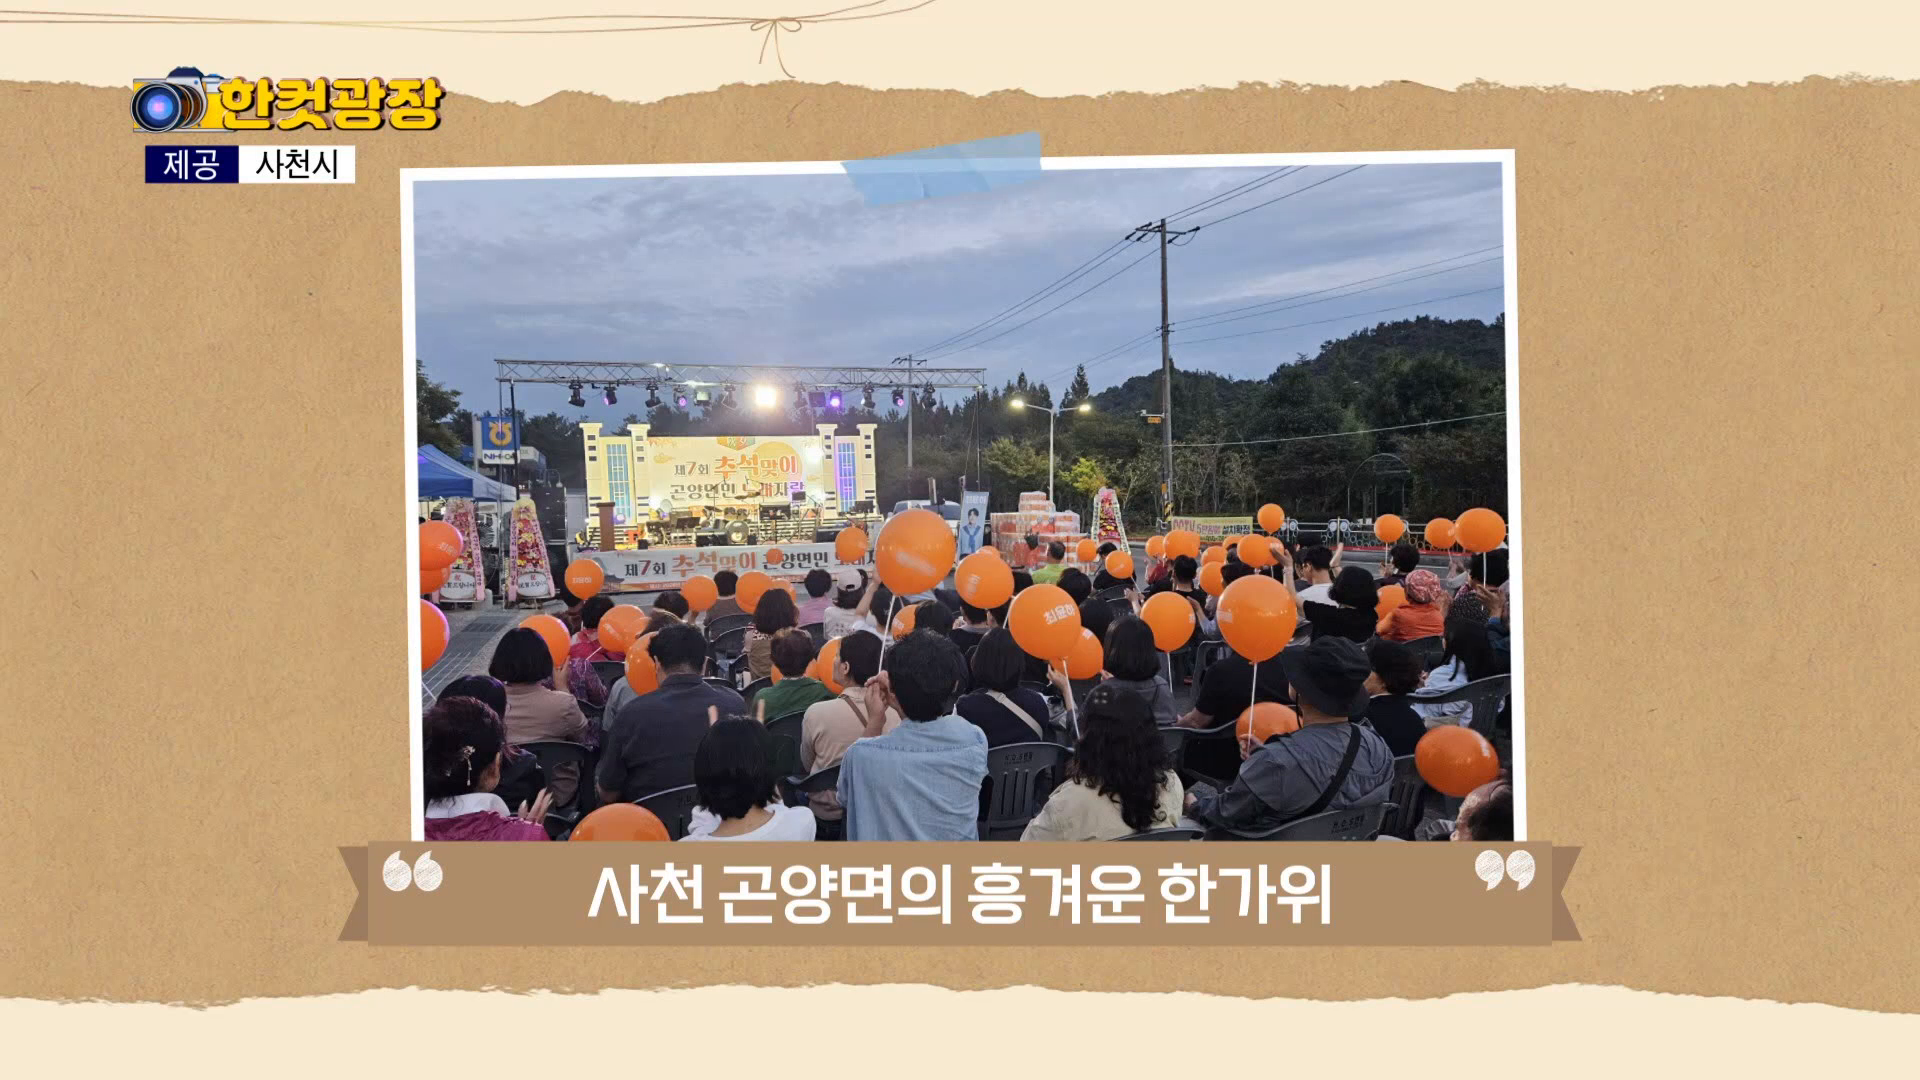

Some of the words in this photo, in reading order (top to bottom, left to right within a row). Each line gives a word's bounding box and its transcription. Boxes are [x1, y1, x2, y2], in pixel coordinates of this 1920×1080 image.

[674, 461, 709, 476] 제7회
[714, 454, 797, 479] 추석맞이
[670, 483, 736, 500] 곤양면민
[625, 559, 666, 577] 제7회
[672, 550, 756, 578] 추석맞이
